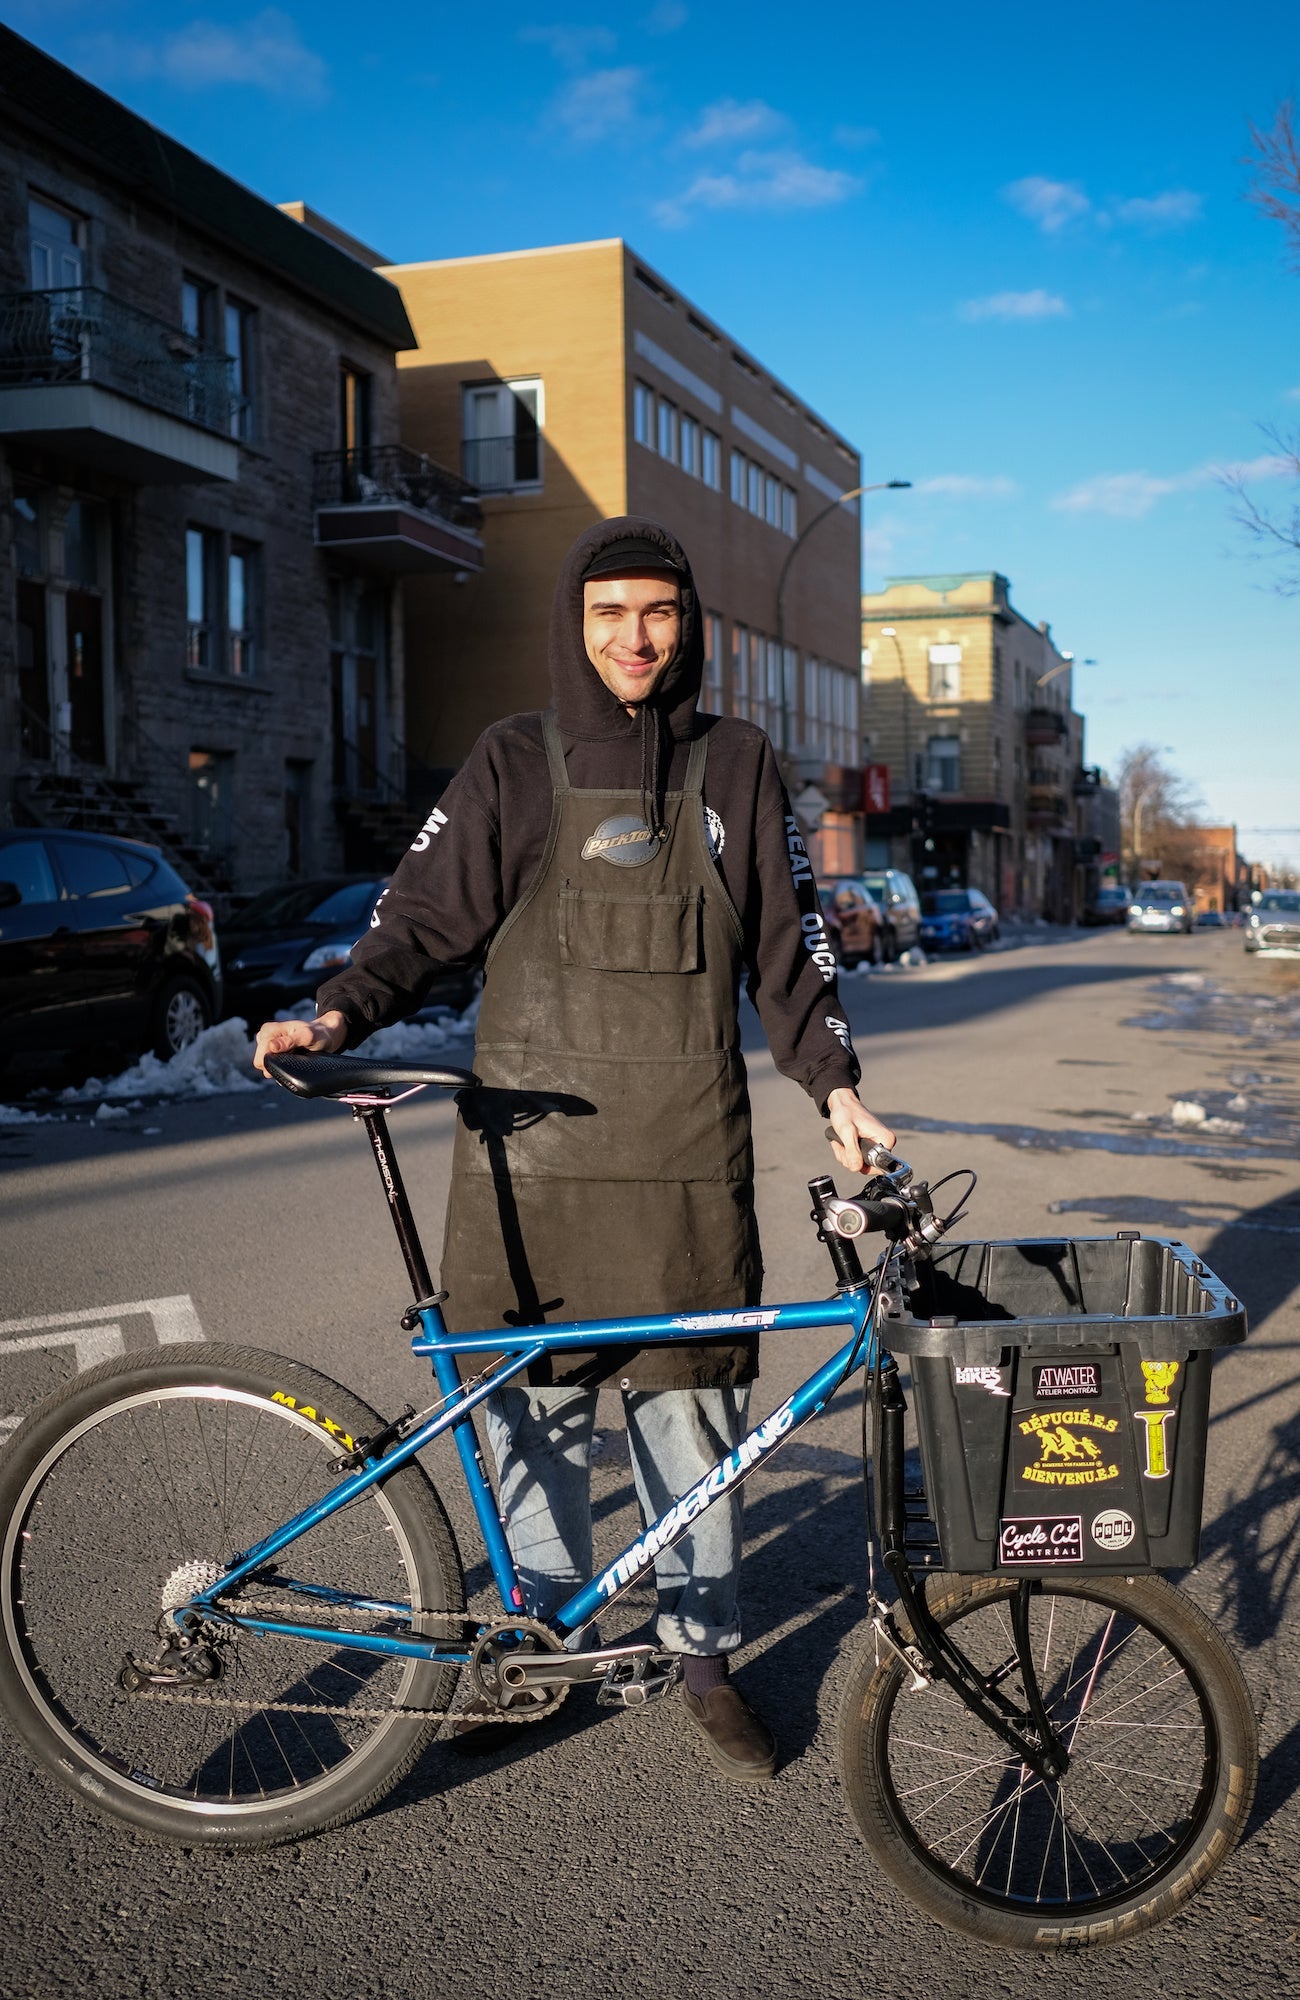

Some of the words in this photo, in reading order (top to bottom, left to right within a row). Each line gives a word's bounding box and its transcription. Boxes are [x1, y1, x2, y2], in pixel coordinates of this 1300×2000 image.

[587, 827, 667, 854] ParkTo
[374, 1135, 396, 1196] THOMSON
[956, 1369, 1002, 1384] BIKES
[1038, 1366, 1096, 1387] ATWATER
[1036, 1388, 1062, 1396] ATELIER
[1019, 1408, 1119, 1435] RÉFUGIÉ.E.S
[1022, 1464, 1119, 1485] BIENVENU.E.S
[596, 1396, 795, 1597] TIMBERLINE
[1002, 1525, 1047, 1549] Cycle
[1095, 1521, 1132, 1539] PAUL
[1006, 1547, 1077, 1557] MONTRÉAL
